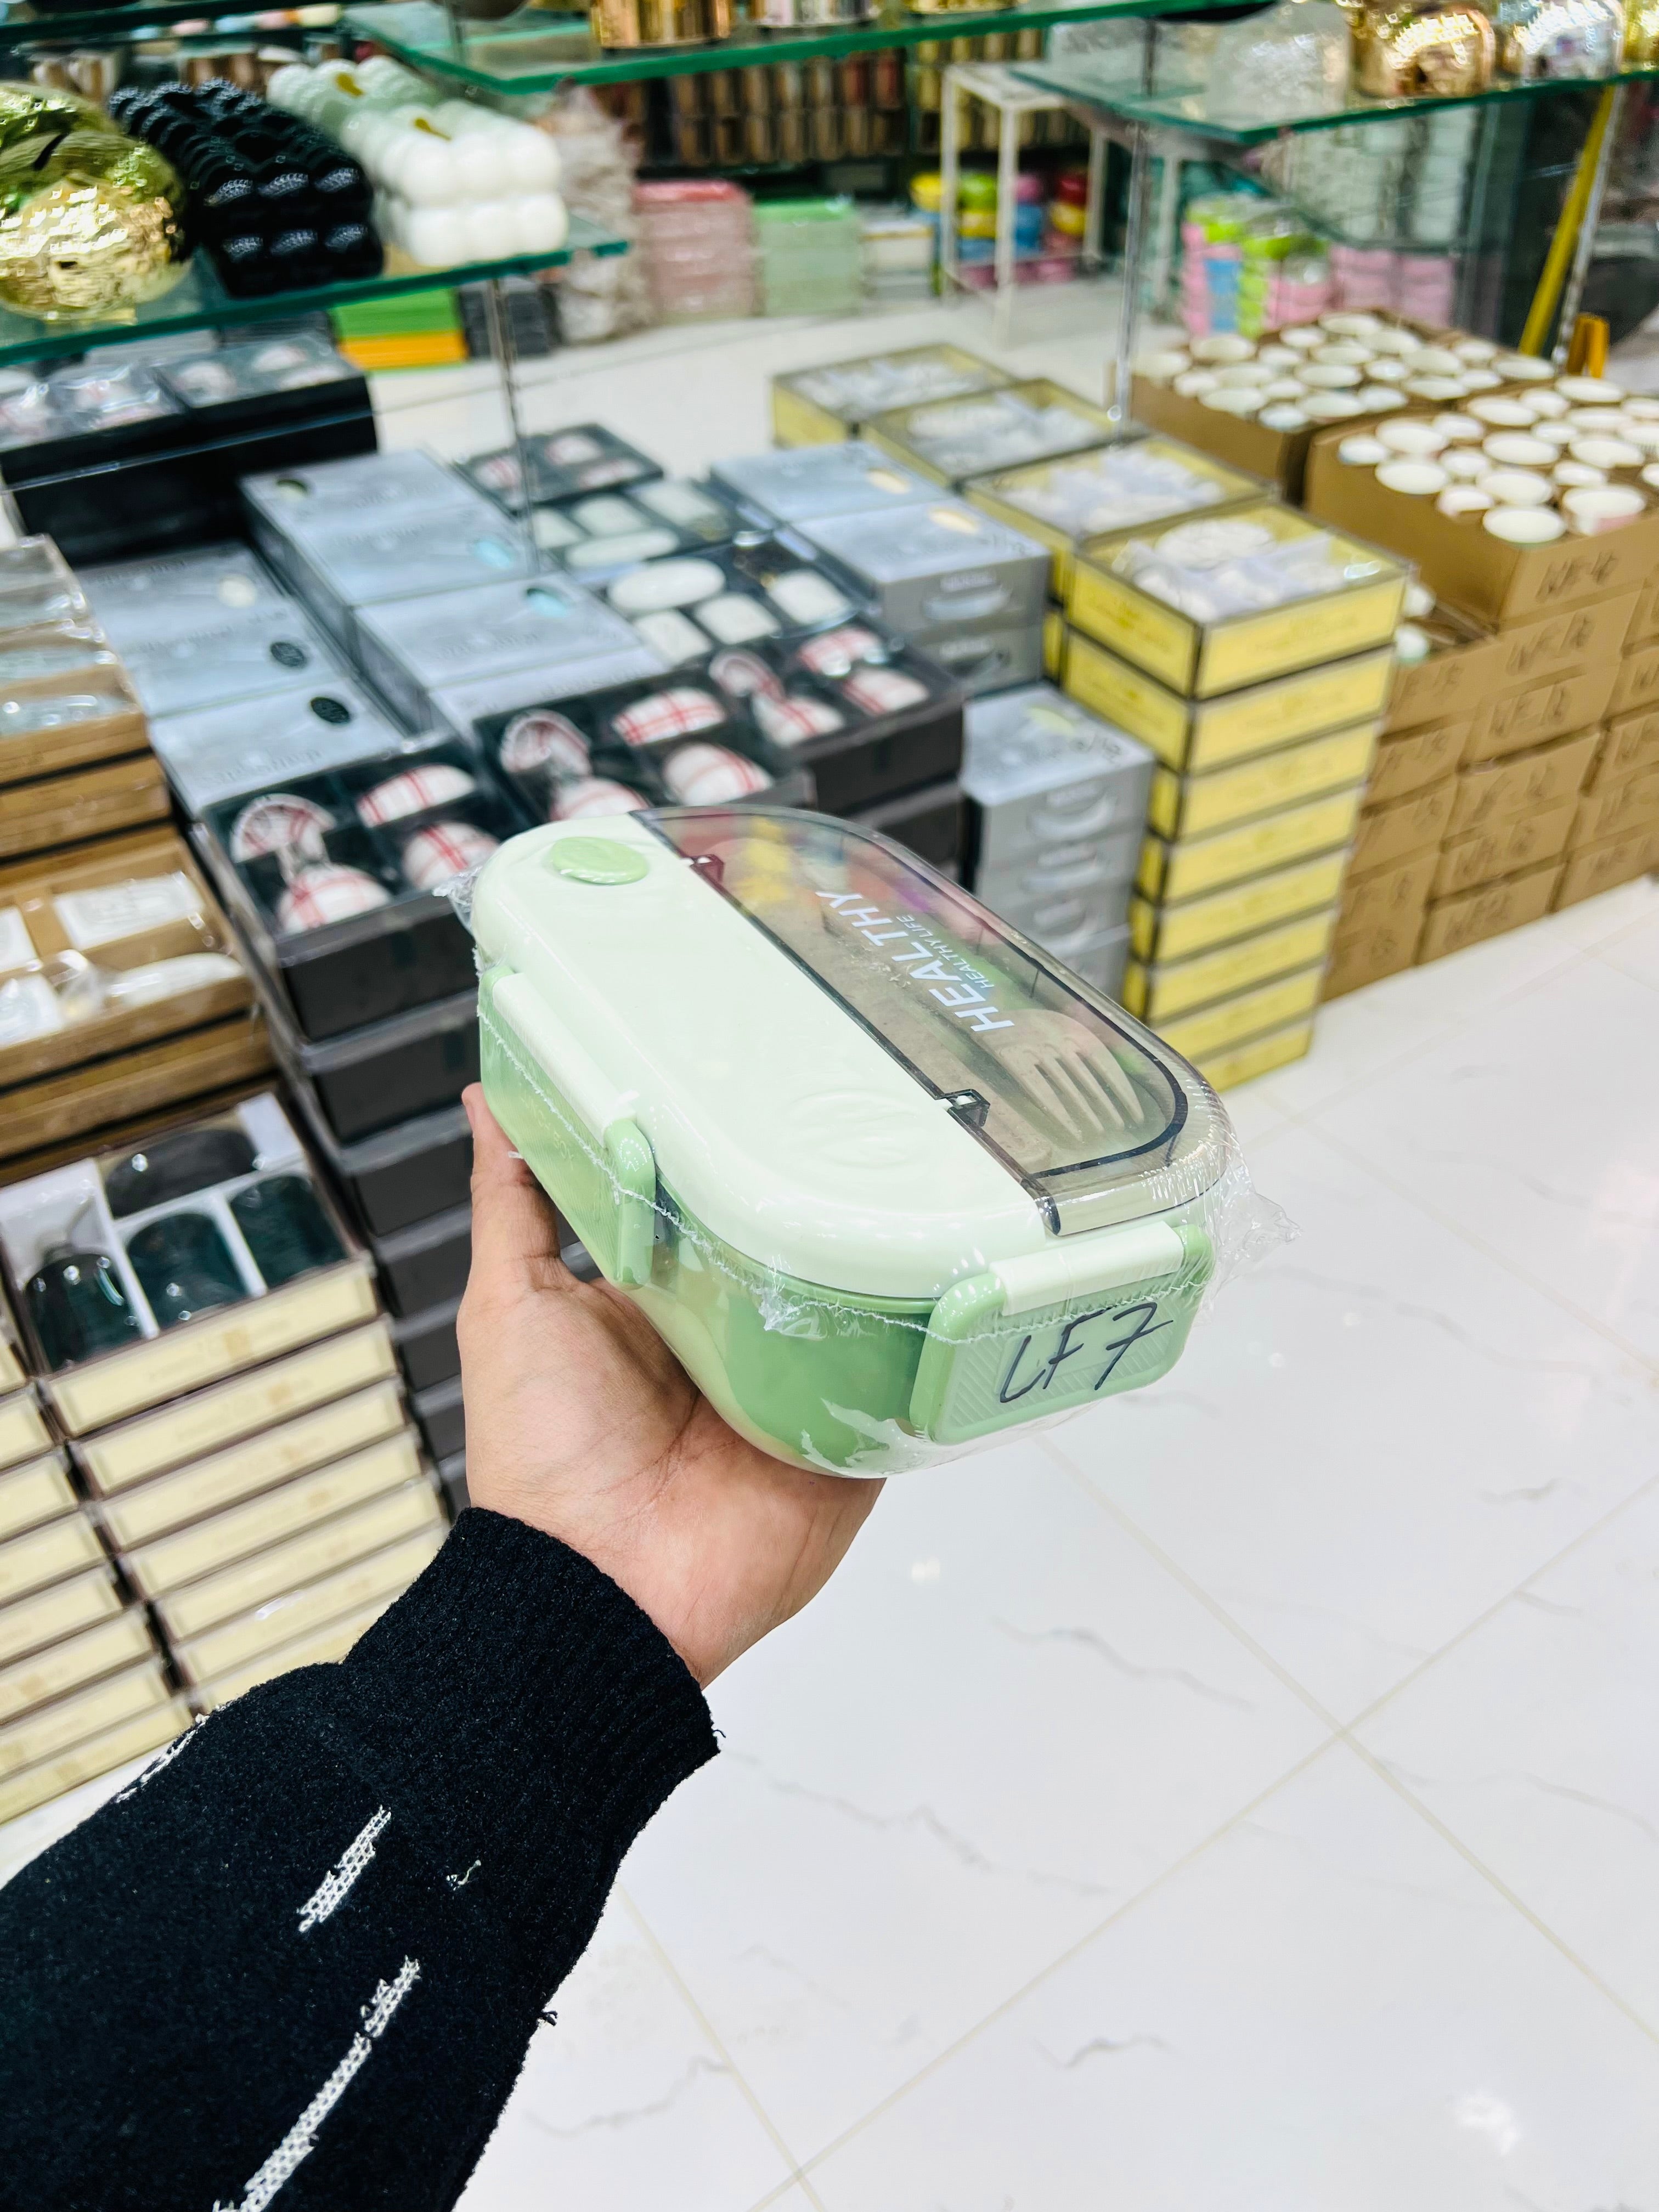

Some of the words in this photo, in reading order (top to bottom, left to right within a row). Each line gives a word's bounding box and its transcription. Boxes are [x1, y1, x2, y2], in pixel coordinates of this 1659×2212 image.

[896, 915, 933, 938] LIFE
[815, 891, 1015, 1032] HEALTHY
[925, 939, 994, 988] HEALTHY
